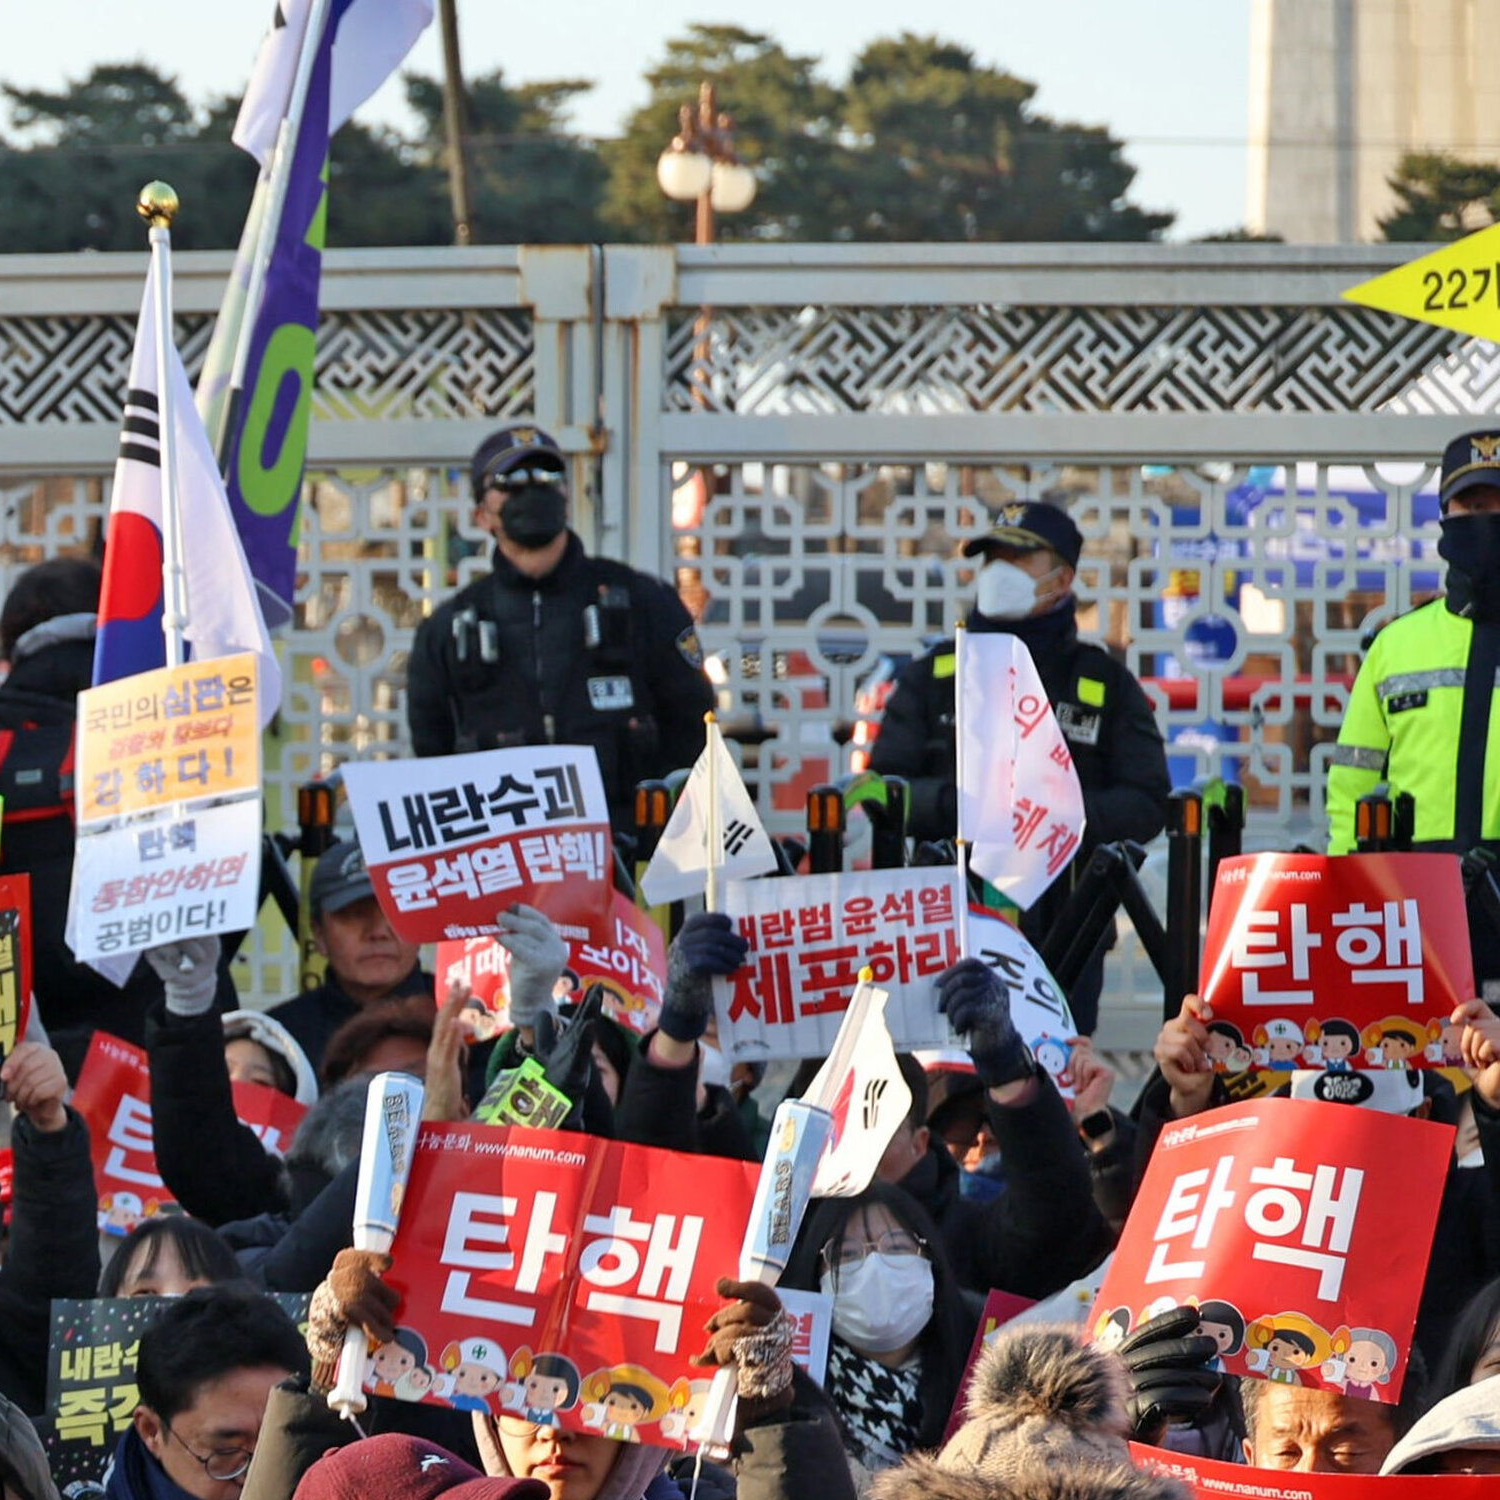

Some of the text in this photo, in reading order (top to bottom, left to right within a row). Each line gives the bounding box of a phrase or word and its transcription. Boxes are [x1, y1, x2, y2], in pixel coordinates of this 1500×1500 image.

[1423, 263, 1500, 312] 227
[378, 764, 587, 852] 내란수괴
[387, 832, 604, 911] 윤석열 탄핵!
[842, 884, 954, 937] 윤석열
[96, 900, 227, 953] 공범이다!
[1232, 899, 1424, 1005] 탄핵
[727, 929, 962, 1024] 체포하라
[474, 1141, 586, 1166] www.nanum.com
[1144, 1155, 1364, 1302] 탄핵
[440, 1191, 703, 1354] 탄핵
